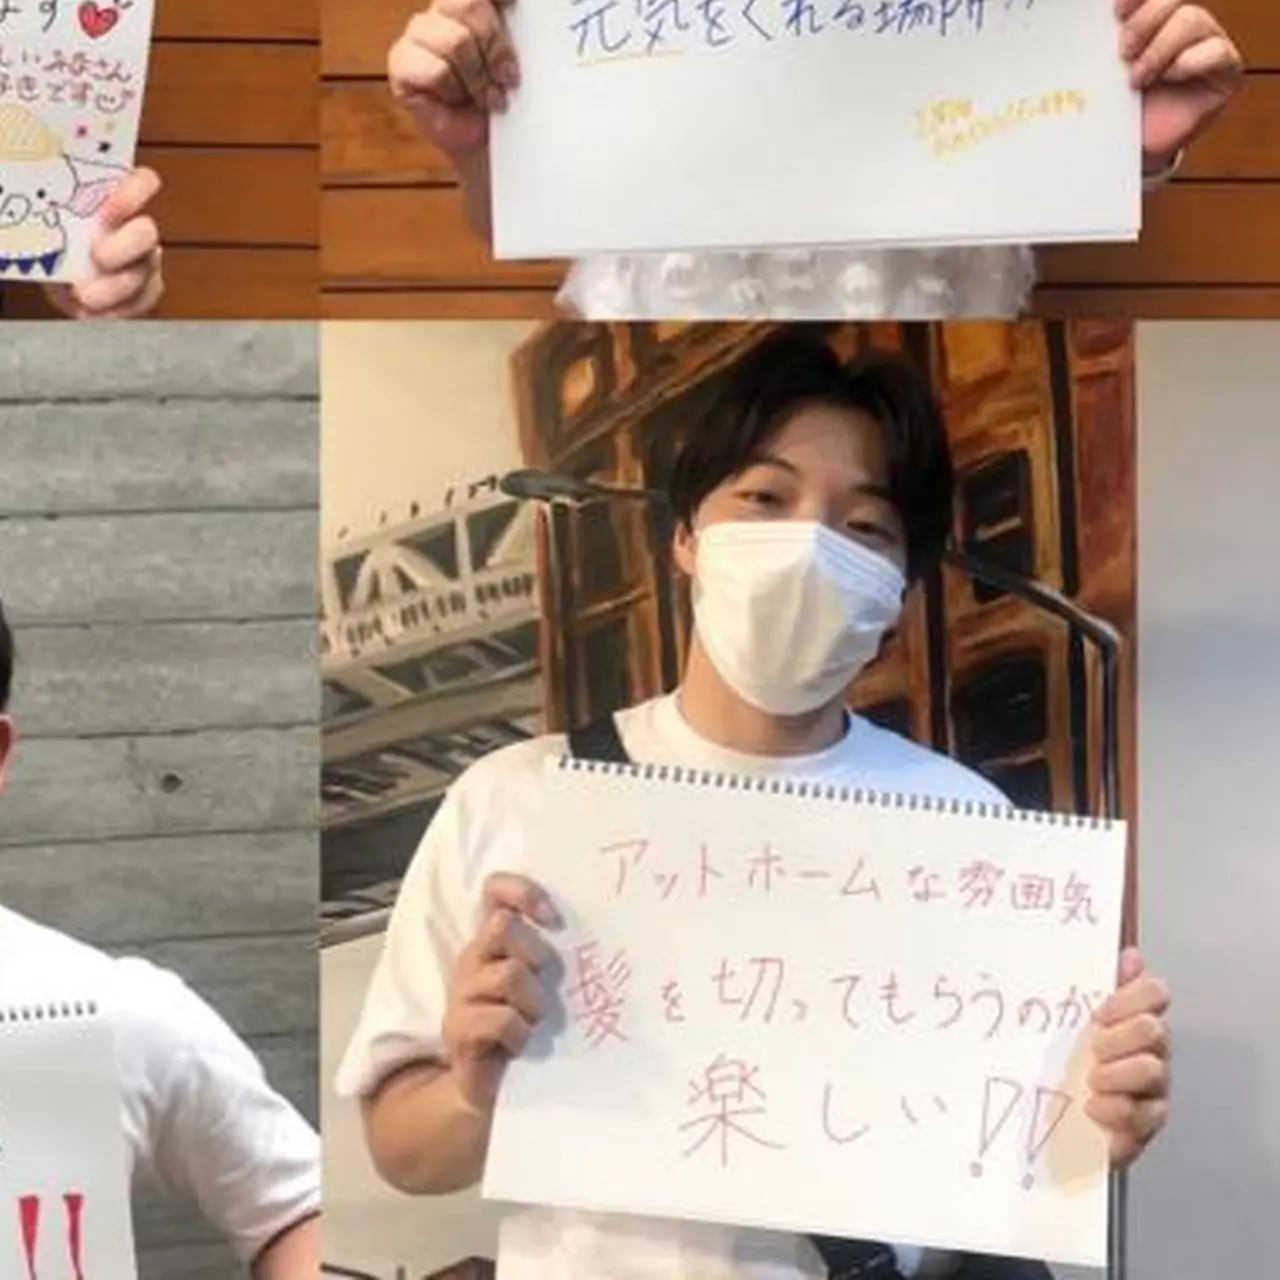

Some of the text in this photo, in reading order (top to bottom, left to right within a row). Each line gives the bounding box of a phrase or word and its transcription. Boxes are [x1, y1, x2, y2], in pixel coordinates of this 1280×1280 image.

[598, 836, 1101, 927] アットホームな雰囲気
[570, 938, 1103, 1049] 髪を切ってもらうのが
